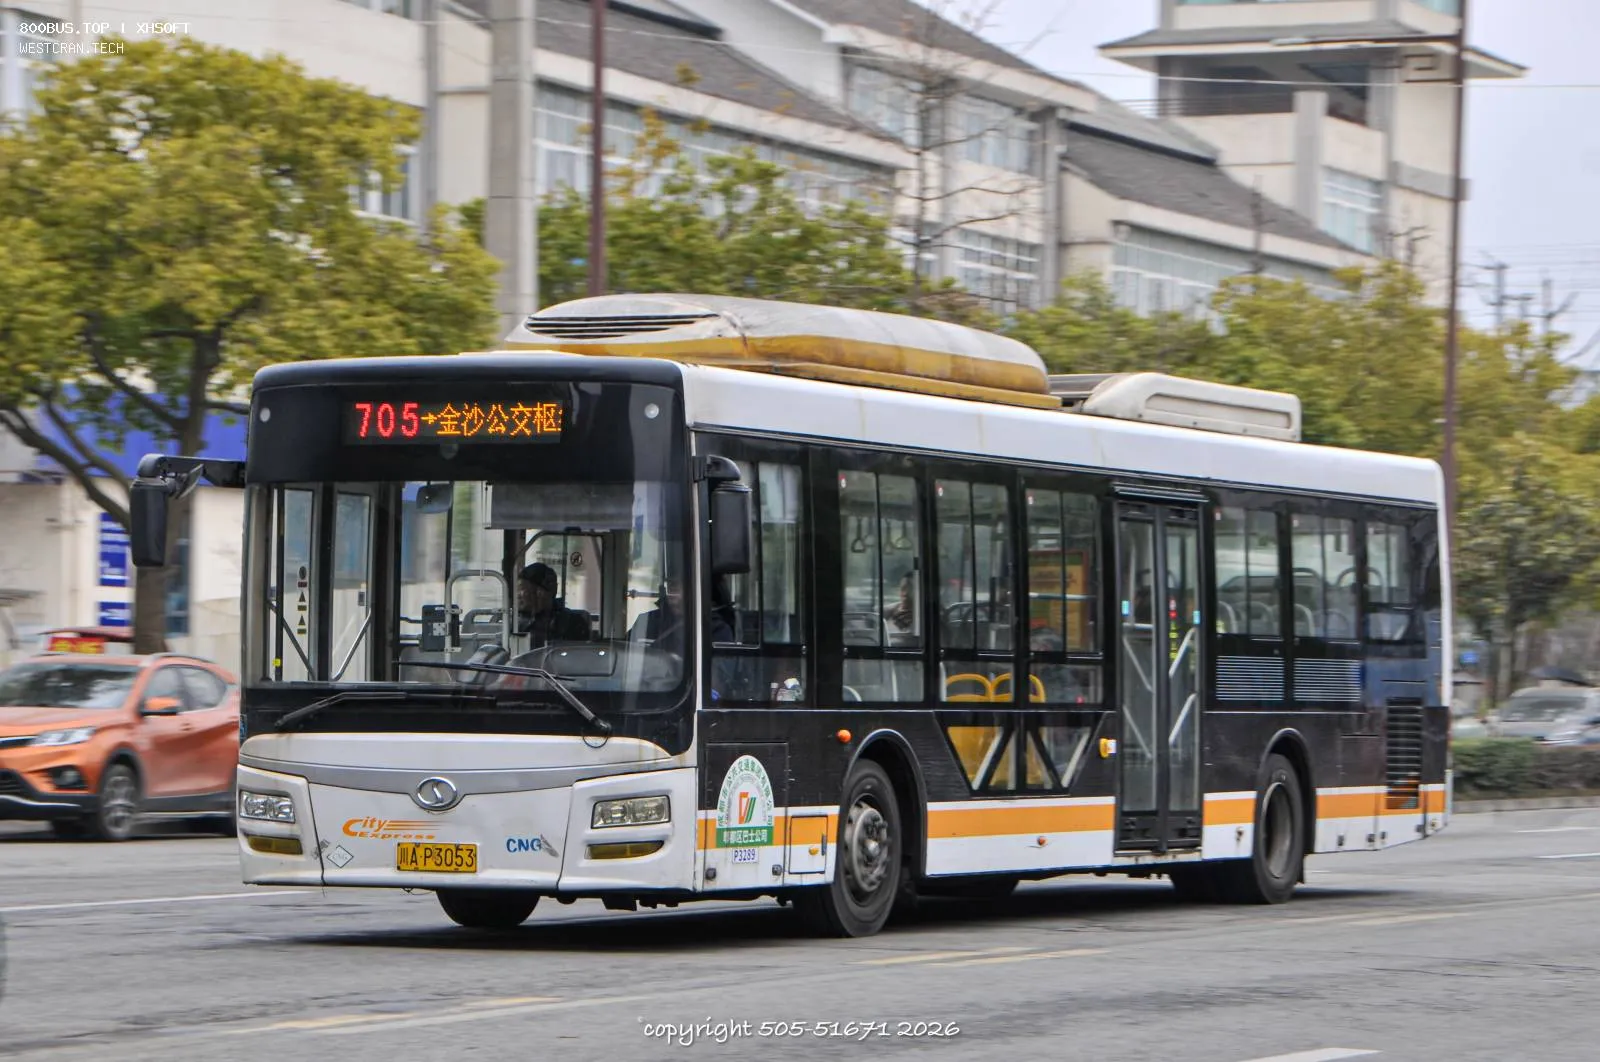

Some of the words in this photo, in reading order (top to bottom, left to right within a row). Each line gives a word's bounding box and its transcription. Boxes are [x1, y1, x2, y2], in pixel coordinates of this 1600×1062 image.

[354, 403, 419, 437] 705
[436, 402, 562, 436] 金沙公交枢
[342, 816, 388, 837] City
[506, 838, 542, 853] CNG
[734, 848, 756, 862] P3289
